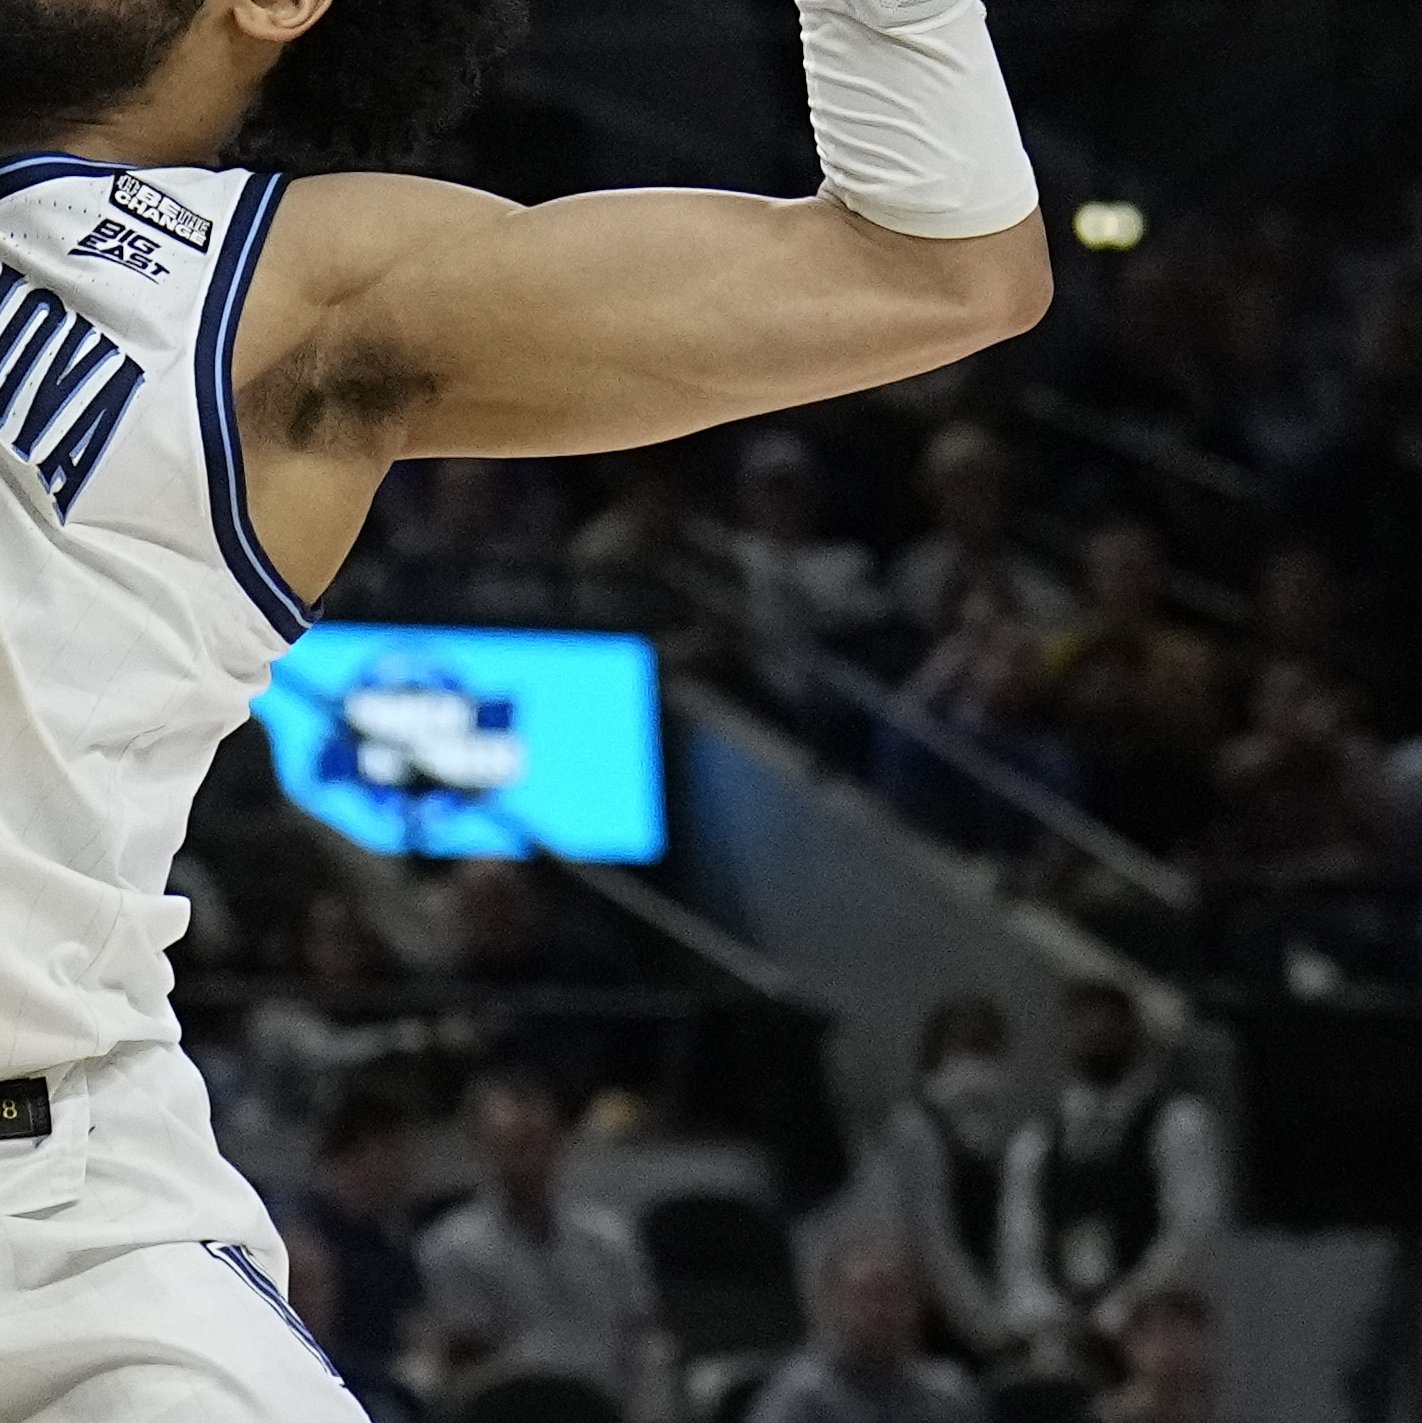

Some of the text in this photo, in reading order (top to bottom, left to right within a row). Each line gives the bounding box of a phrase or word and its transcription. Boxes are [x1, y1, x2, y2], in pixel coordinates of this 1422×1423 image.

[92, 218, 162, 255] BIG
[114, 190, 207, 247] CHANGE
[77, 234, 171, 276] EAST
